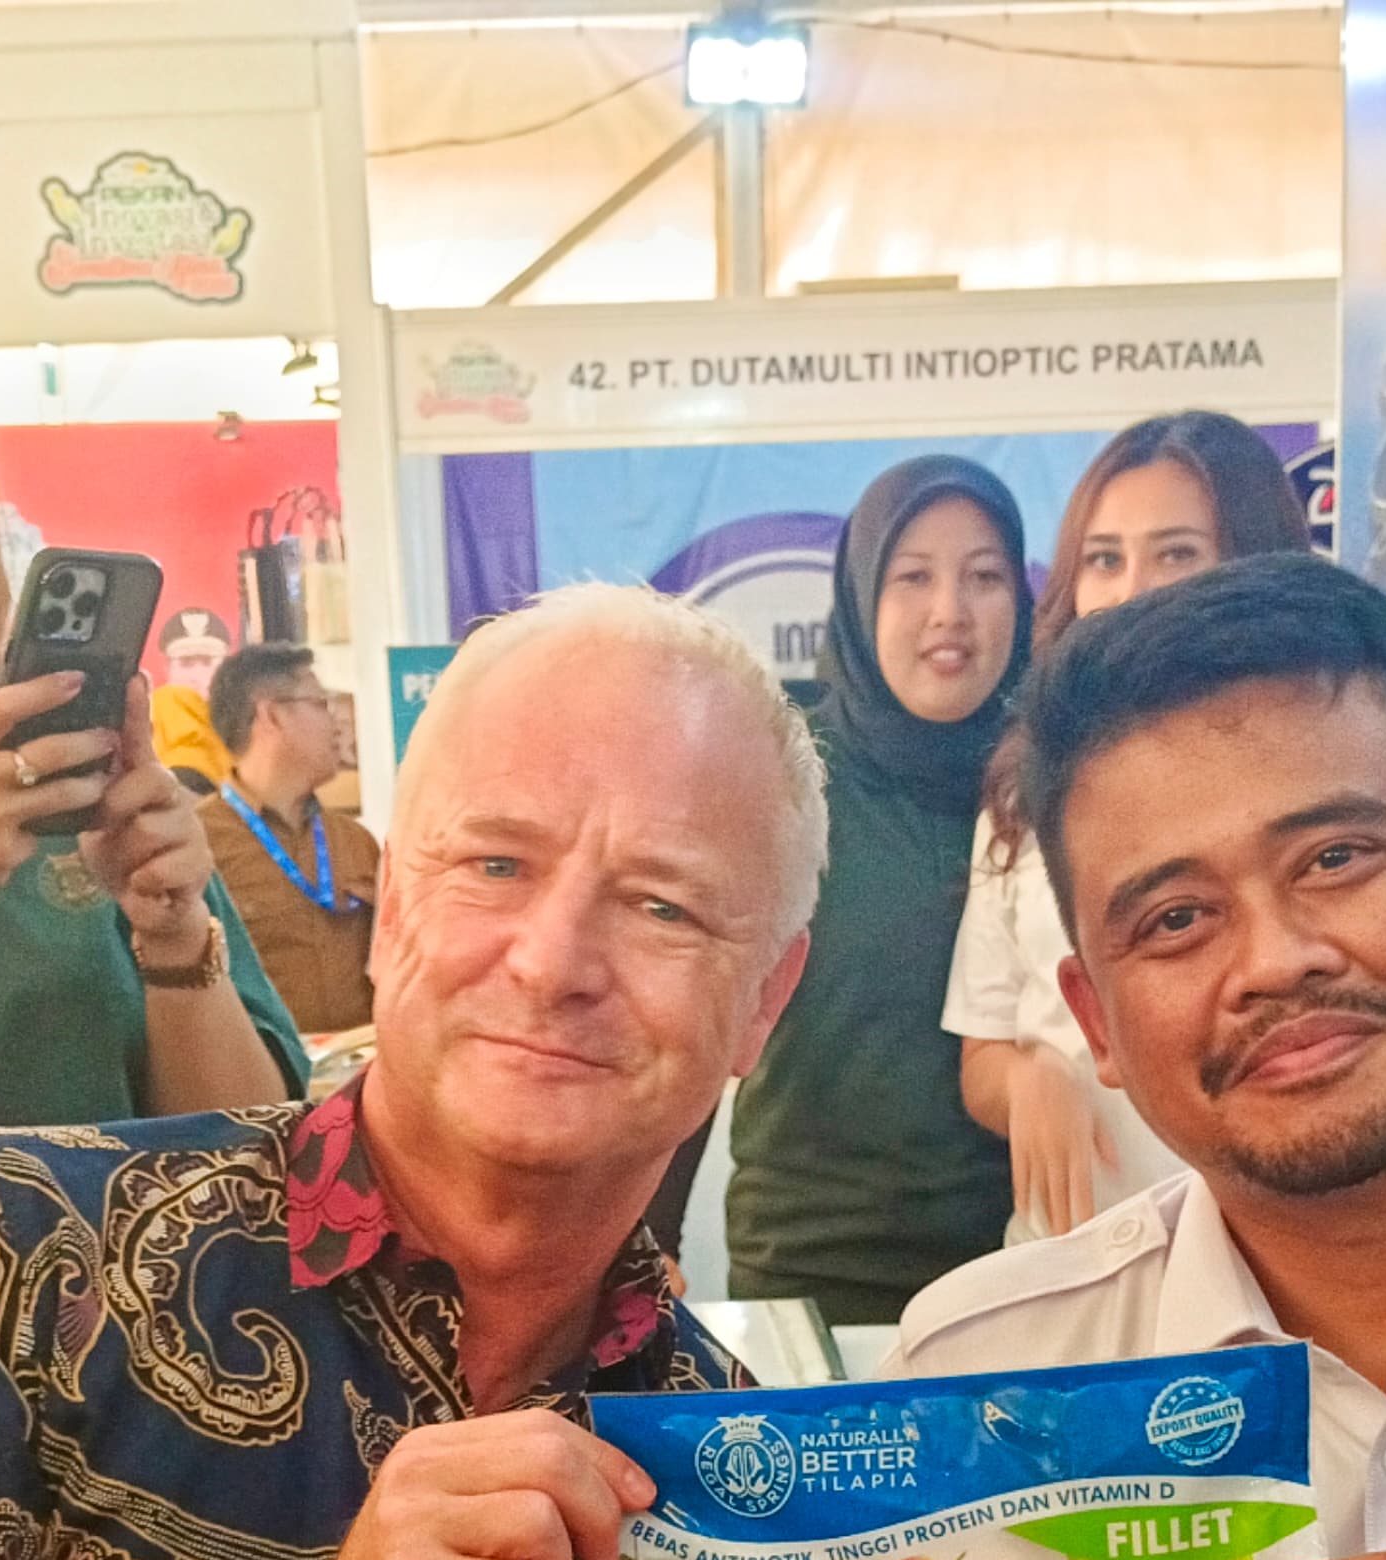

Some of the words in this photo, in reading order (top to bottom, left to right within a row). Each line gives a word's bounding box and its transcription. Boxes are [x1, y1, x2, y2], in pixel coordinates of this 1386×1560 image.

[569, 361, 616, 390] 42.
[629, 360, 679, 389] PT.
[691, 352, 893, 387] DUTAMULTI
[904, 345, 1080, 379] INTIOPTIC
[1092, 339, 1266, 372] PRATAMA
[801, 1428, 918, 1447] NATURALLY
[1151, 1416, 1192, 1438] EXPORT
[1195, 1403, 1240, 1426] QUALITY
[700, 1445, 737, 1508] REGAL
[746, 1440, 791, 1512] SPRINGS
[802, 1448, 917, 1474] BETTER
[803, 1473, 917, 1492] TILAPIA
[631, 1520, 689, 1559] BEBAS
[905, 1504, 995, 1548] PROTEIN
[1001, 1493, 1051, 1518] DAN
[1056, 1482, 1151, 1506] VITAMIN
[1159, 1482, 1176, 1499] D
[1106, 1507, 1234, 1558] FILLET
